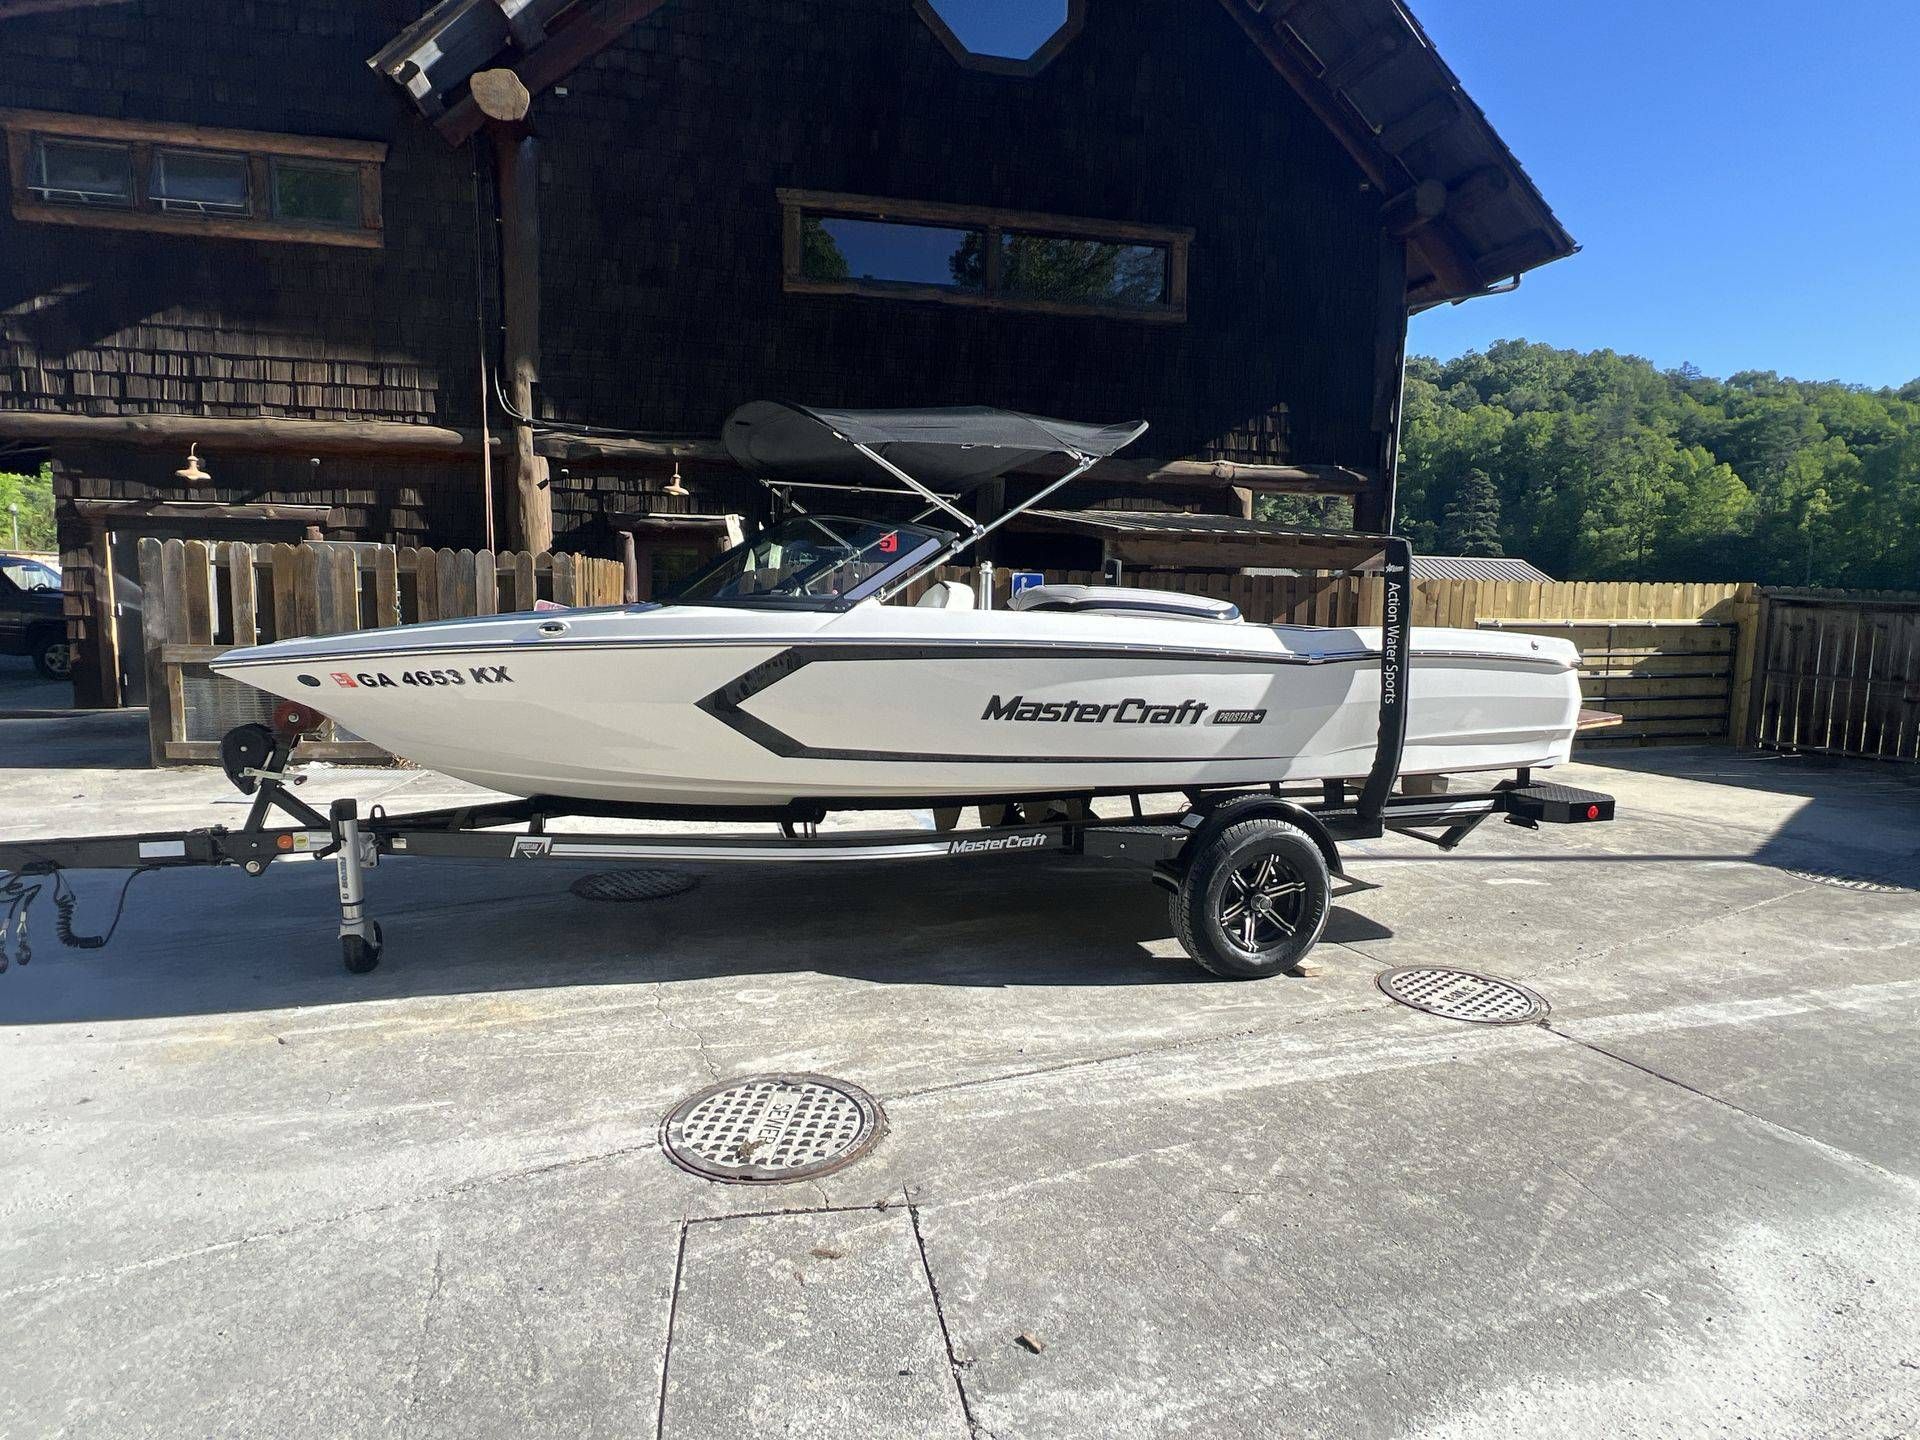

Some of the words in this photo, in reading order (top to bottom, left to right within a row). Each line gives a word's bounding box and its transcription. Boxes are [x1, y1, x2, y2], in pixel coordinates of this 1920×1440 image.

[1388, 582, 1401, 622] Action
[1387, 625, 1400, 662] Water
[357, 673, 399, 687] GA
[402, 670, 465, 686] 4653
[469, 666, 514, 683] KX
[1384, 665, 1398, 704] Sports
[981, 695, 1208, 725] MasterCraft
[1217, 711, 1254, 722] PROSTAR
[951, 834, 1047, 853] MasterCraft
